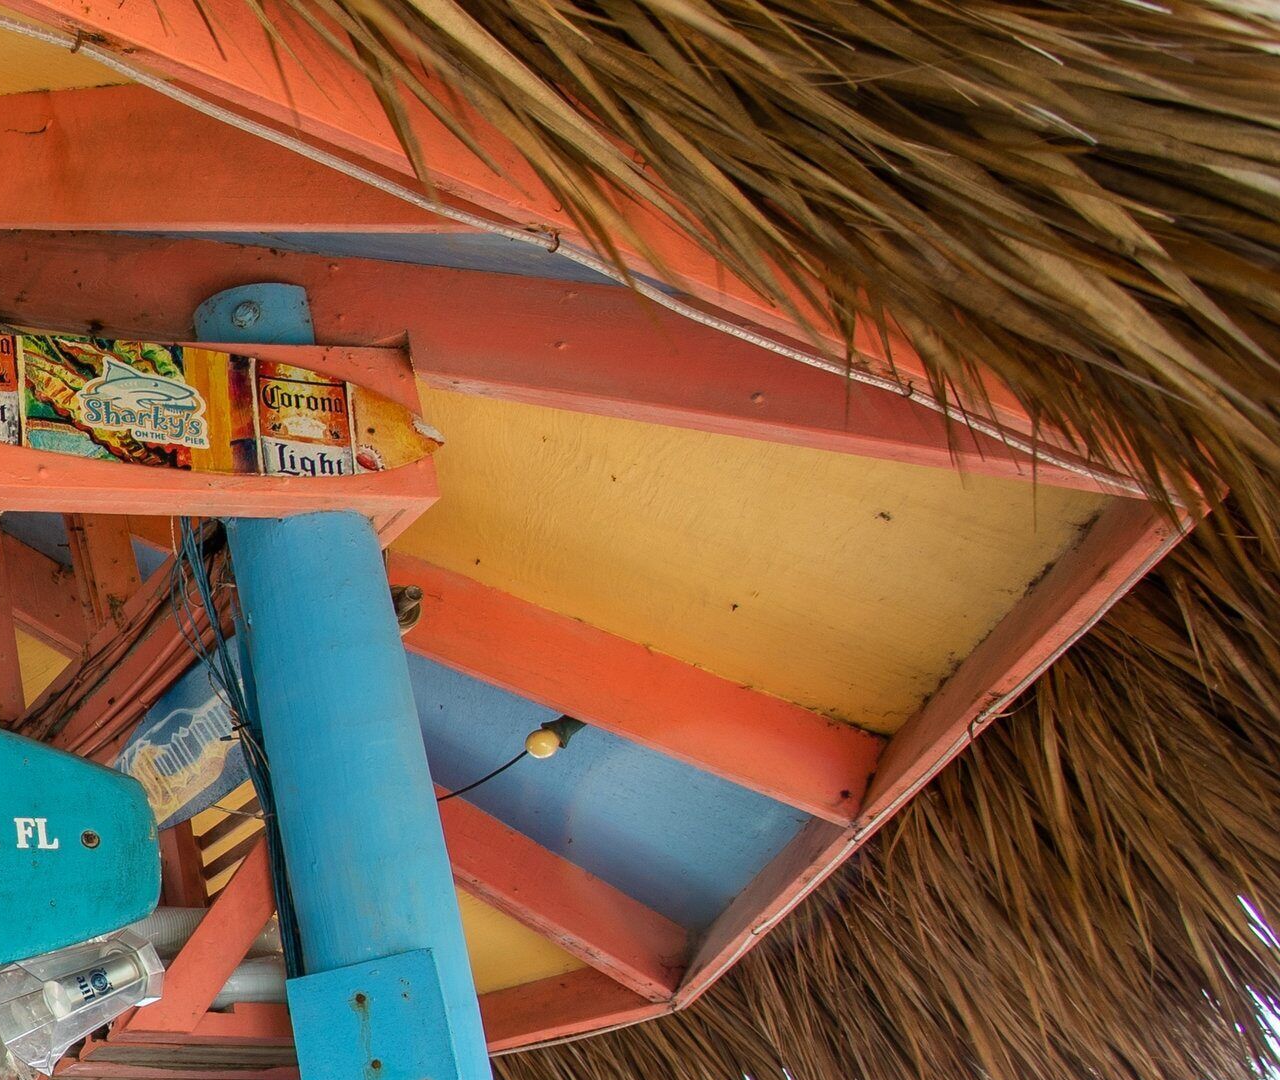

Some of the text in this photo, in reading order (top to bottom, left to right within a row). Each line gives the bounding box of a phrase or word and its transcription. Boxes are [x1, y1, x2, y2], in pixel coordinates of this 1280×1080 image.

[262, 383, 343, 413] Corona
[85, 399, 201, 438] Sharky's
[134, 430, 205, 446] ON THE PIER
[275, 442, 344, 477] Light
[13, 817, 59, 850] FL
